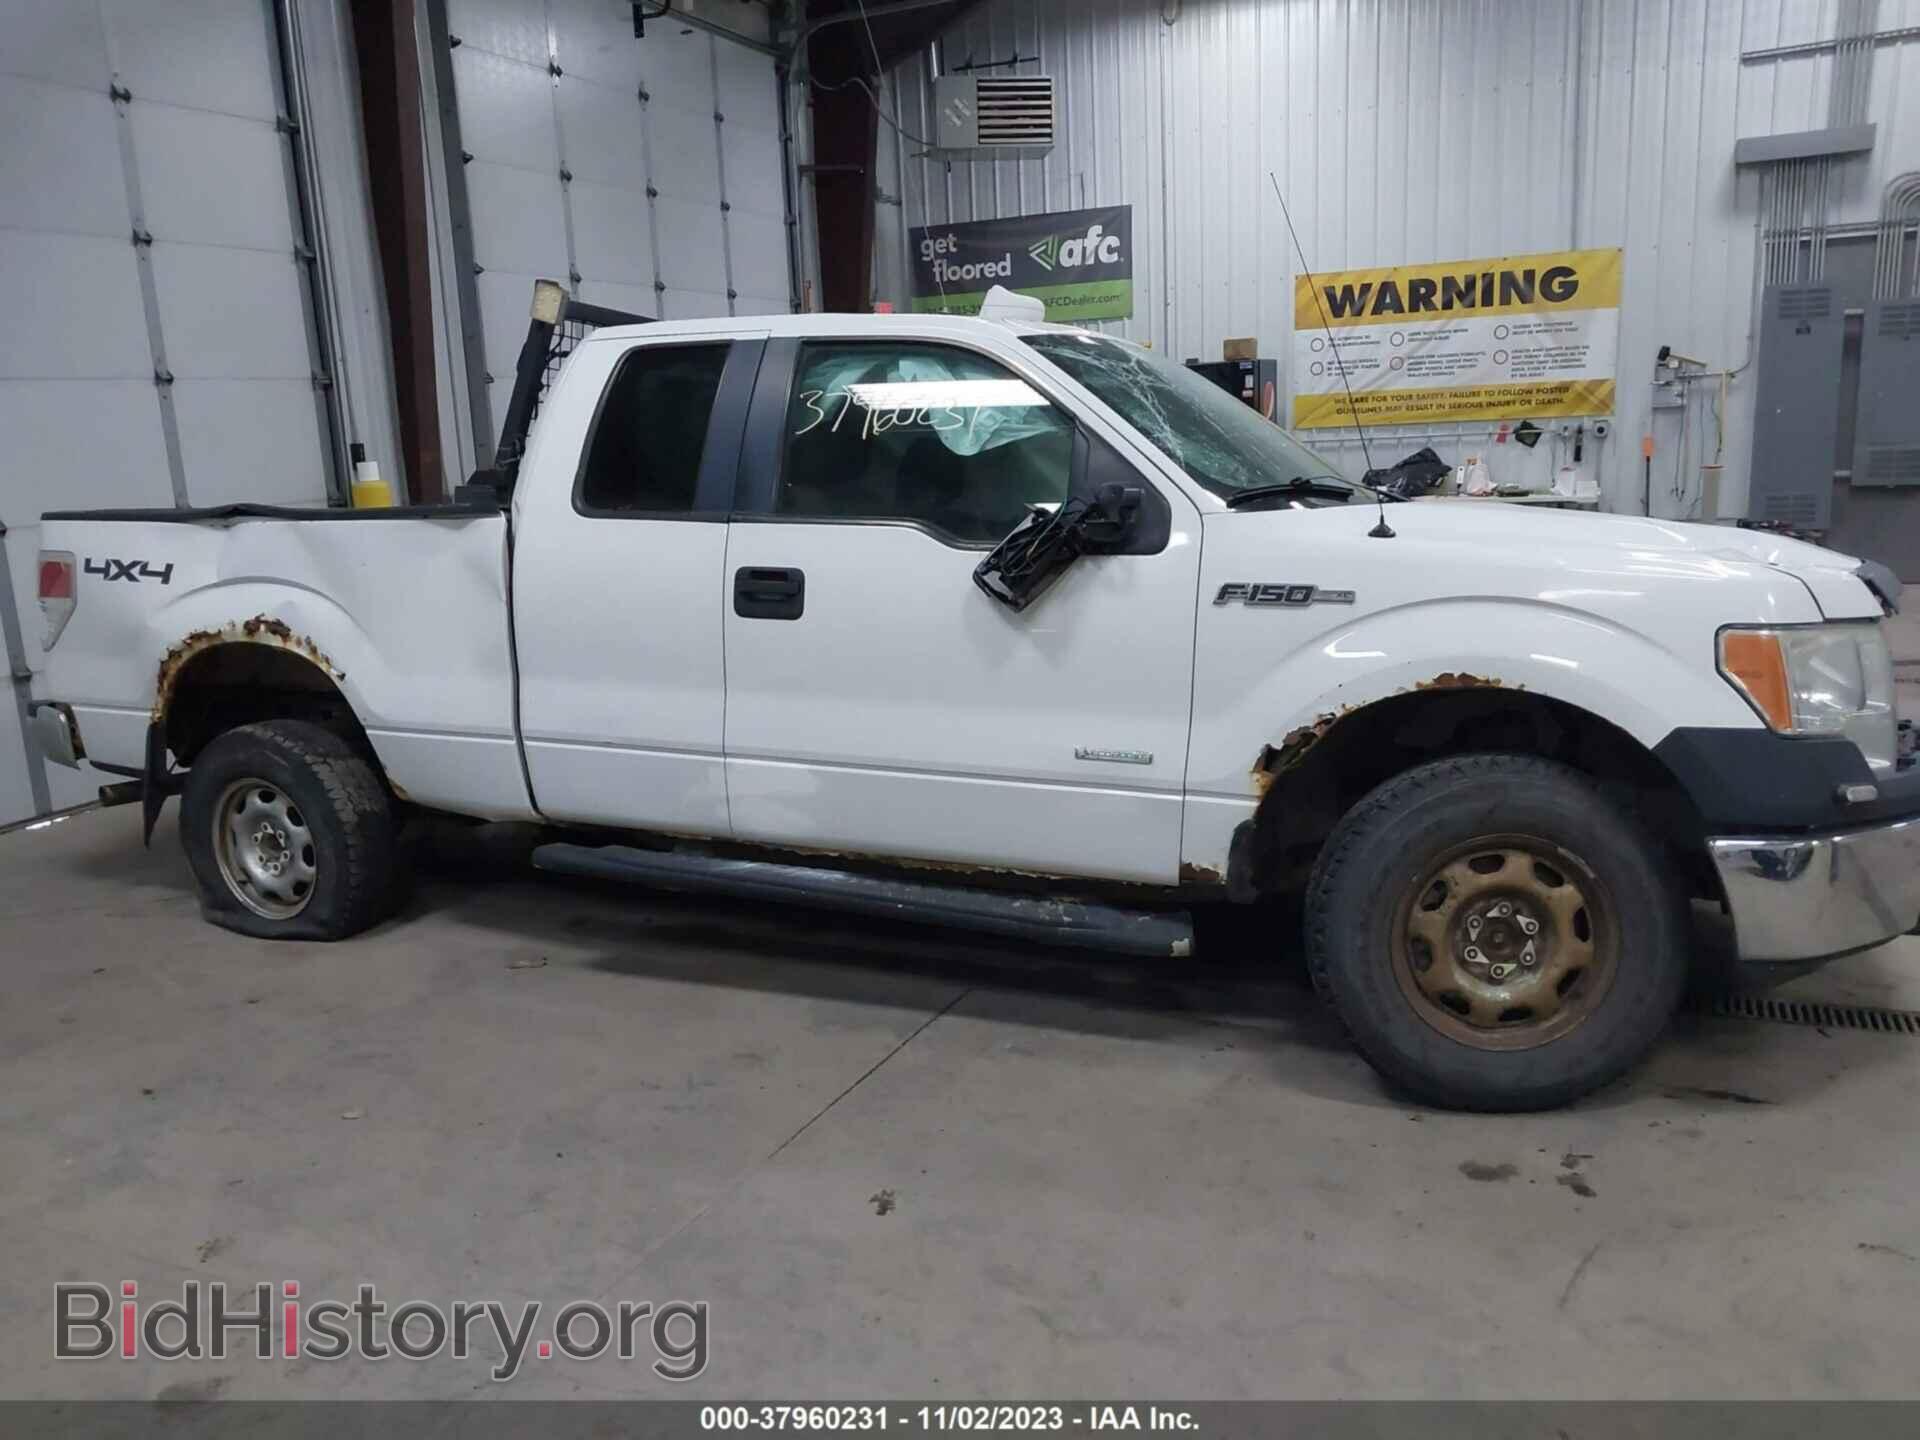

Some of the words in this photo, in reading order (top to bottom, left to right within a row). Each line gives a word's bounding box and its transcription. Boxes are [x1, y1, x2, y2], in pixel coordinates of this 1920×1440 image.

[920, 233, 958, 262] get
[1058, 225, 1121, 267] afc
[932, 253, 1012, 282] floored
[1324, 266, 1579, 319] WARNING
[1371, 394, 1388, 403] FOR
[1391, 393, 1414, 402] YOUR
[1448, 390, 1481, 399] FAILURE
[1484, 389, 1495, 397] TO
[1497, 388, 1534, 397] FOLLOW
[1536, 386, 1570, 395] POSTED
[1405, 403, 1433, 412] RESULT
[1436, 402, 1446, 410] IN
[1448, 400, 1483, 410] SERIOUS
[1486, 399, 1517, 408] INJURY
[1519, 398, 1533, 407] OR
[1213, 582, 1318, 606] F-150
